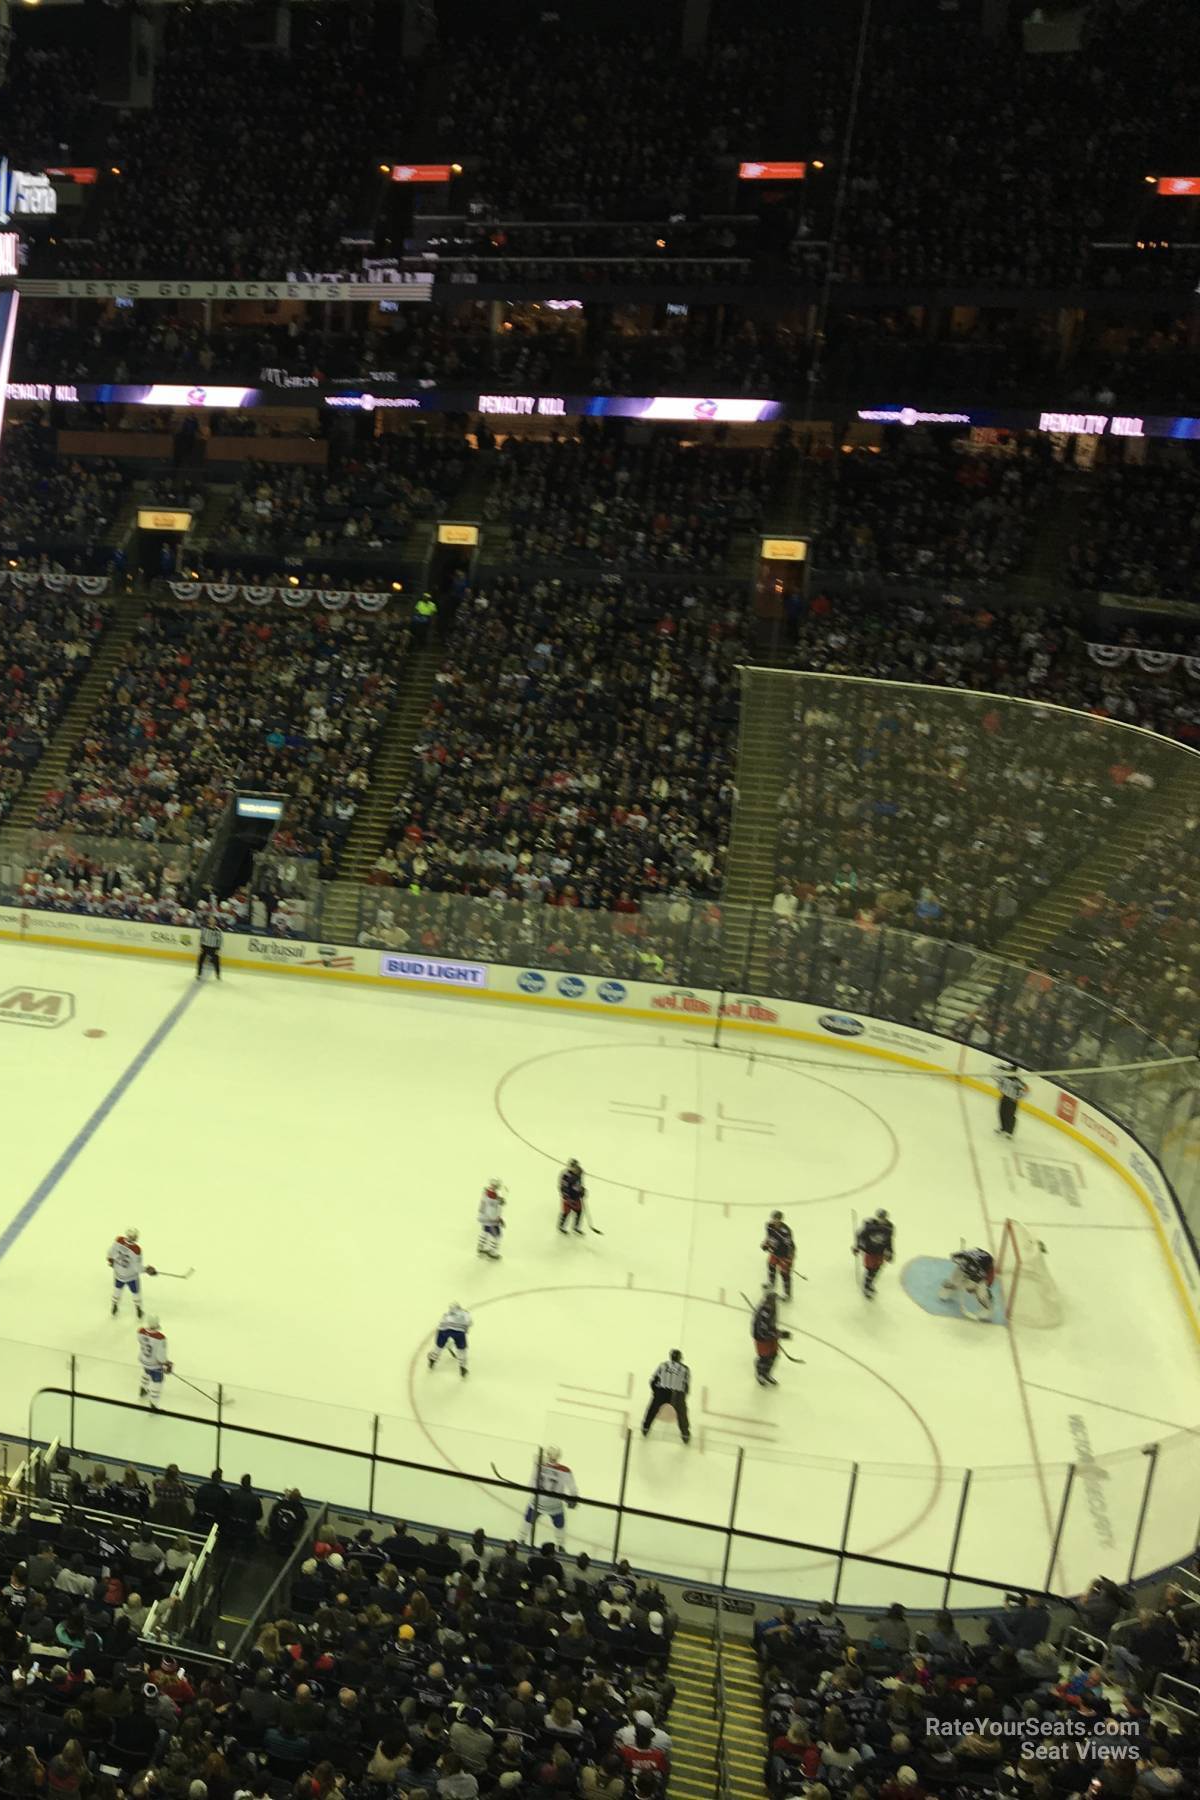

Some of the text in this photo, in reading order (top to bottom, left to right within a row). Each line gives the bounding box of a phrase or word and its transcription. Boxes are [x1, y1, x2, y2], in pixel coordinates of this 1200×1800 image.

[67, 282, 343, 300] LET'S GO JACKETS
[6, 384, 80, 402] PENALTY KILL
[478, 395, 567, 416] PENALTY KILL
[1039, 412, 1145, 437] PENALTY KILL
[31, 918, 80, 930] SECURITY
[386, 958, 481, 983] BUD LIGHT
